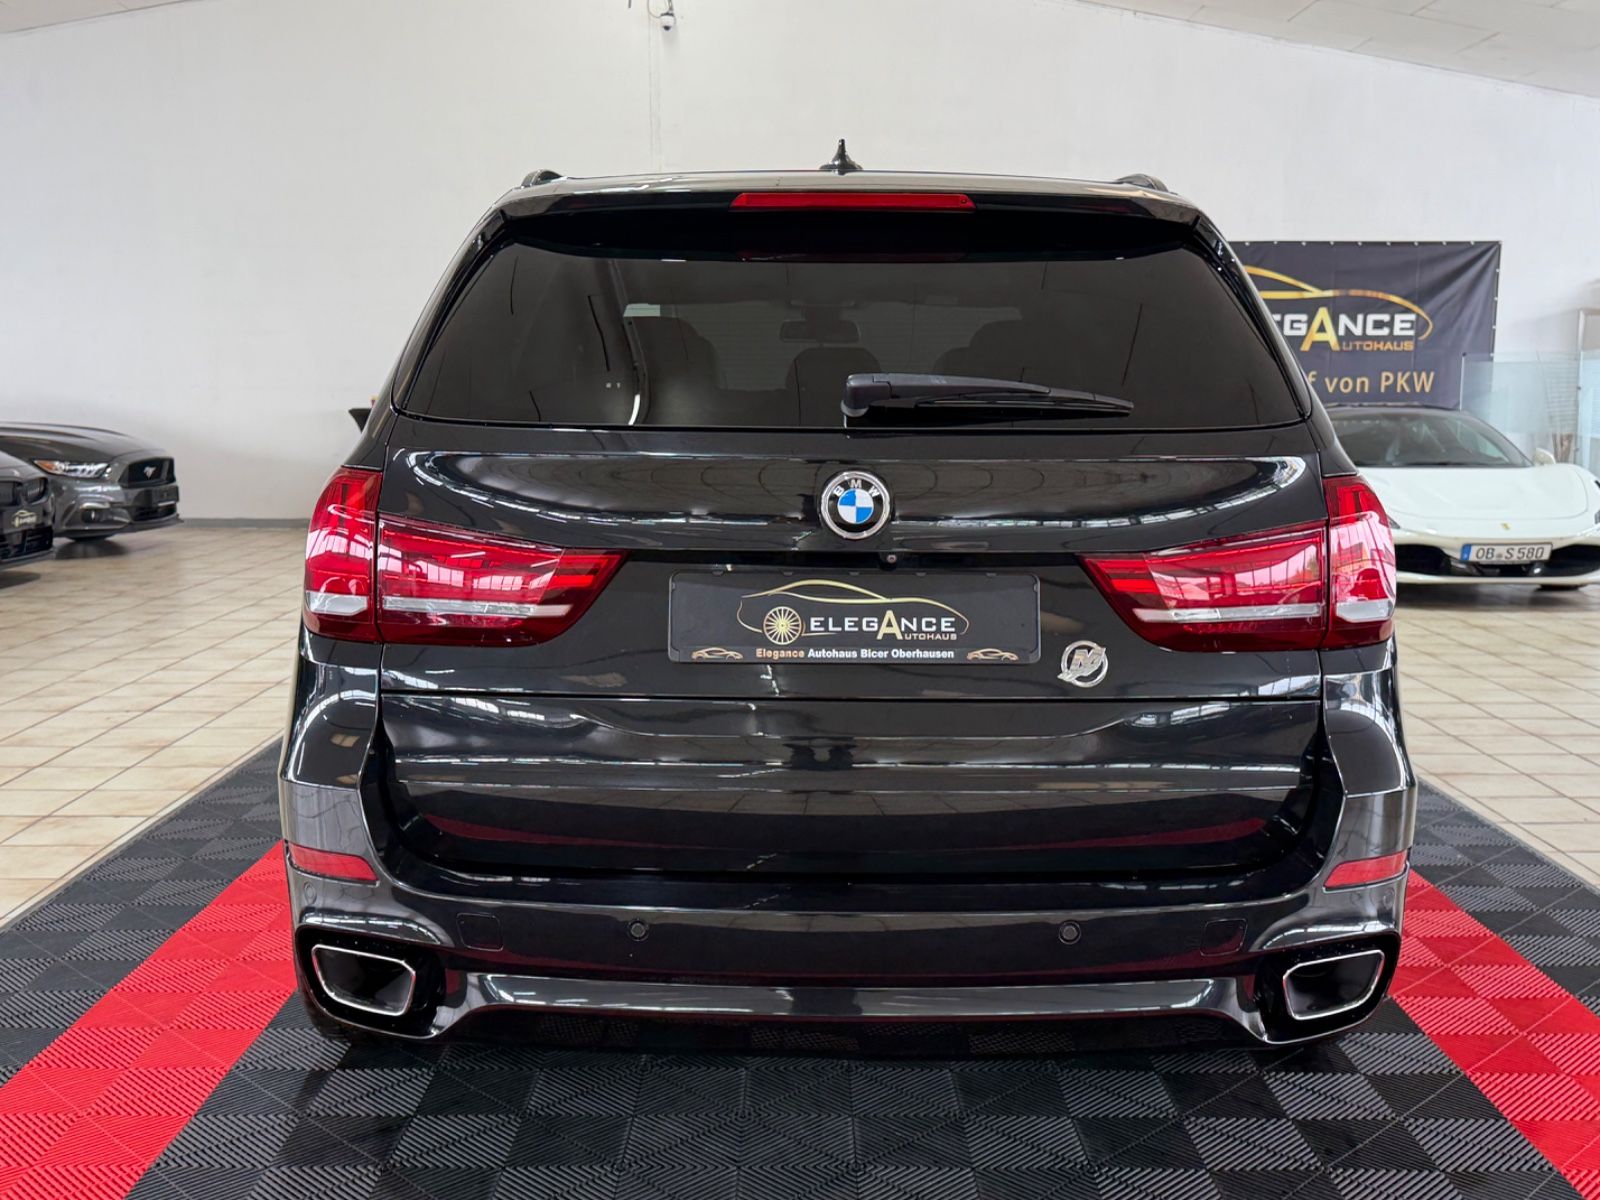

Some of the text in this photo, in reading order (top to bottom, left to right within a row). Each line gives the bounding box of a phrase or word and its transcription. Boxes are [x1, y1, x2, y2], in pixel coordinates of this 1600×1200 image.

[1272, 307, 1417, 352] GANCE
[1324, 376, 1369, 393] von
[1380, 371, 1435, 393] PKW
[833, 479, 880, 498] BMW
[1475, 547, 1495, 560] OB
[1516, 546, 1545, 559] 580
[810, 609, 956, 641] ELEGANCE
[756, 648, 955, 660] Elegance Autohaus Bicer Oberhausen
